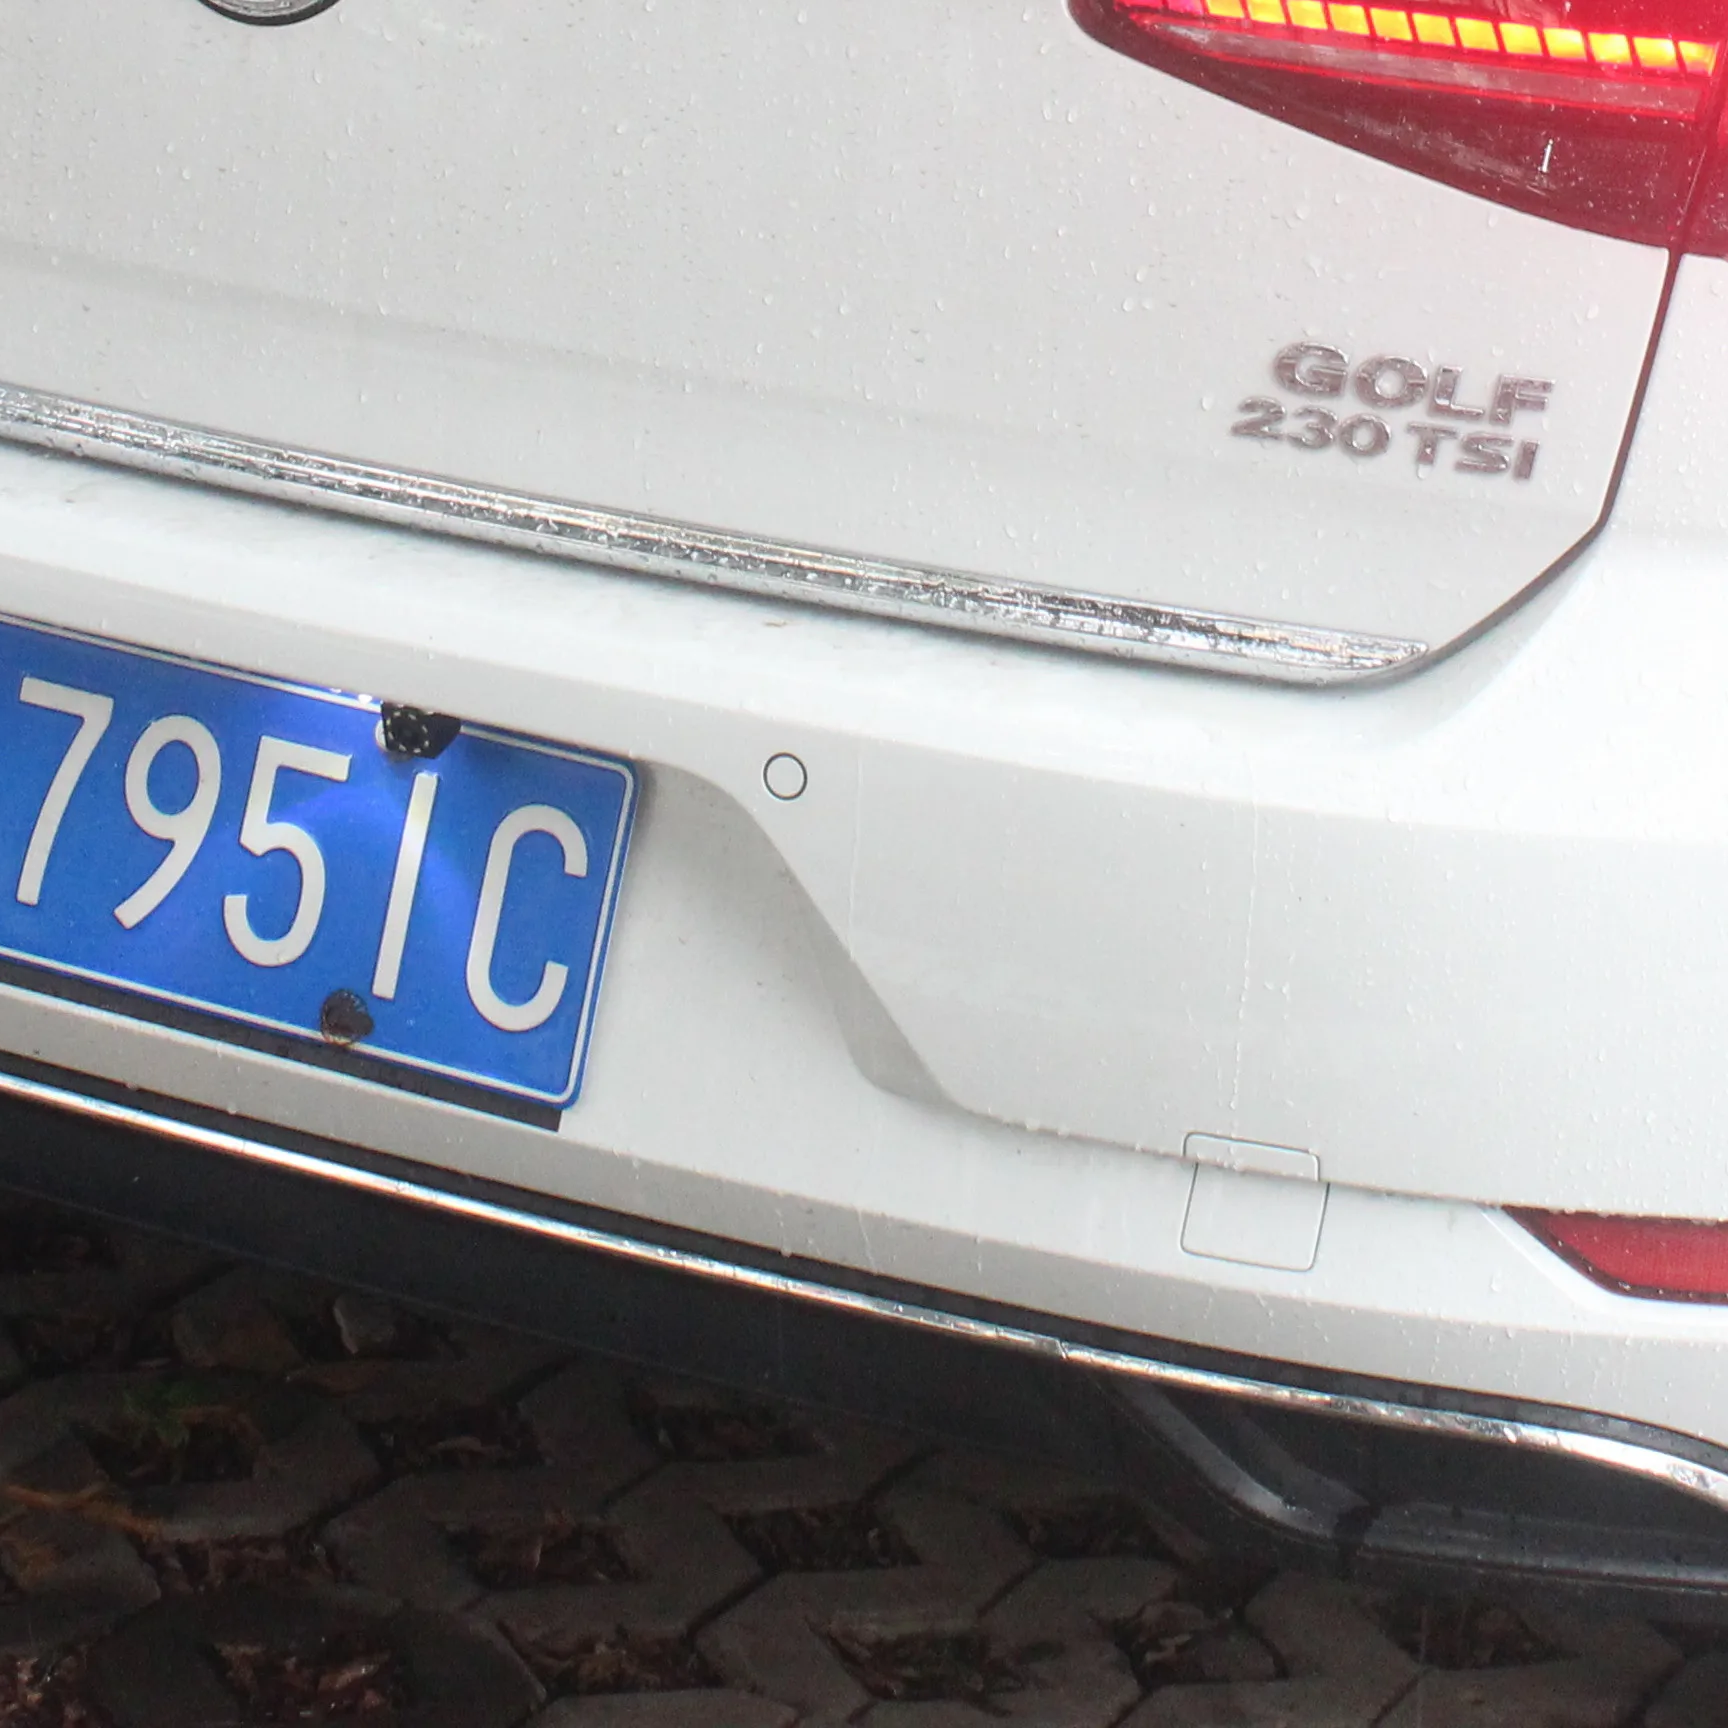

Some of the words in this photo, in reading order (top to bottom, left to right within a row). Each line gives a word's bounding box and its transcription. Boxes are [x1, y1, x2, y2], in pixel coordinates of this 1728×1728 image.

[1273, 340, 1556, 426] GOLF
[1230, 395, 1392, 457] 230
[1406, 421, 1540, 481] TSI
